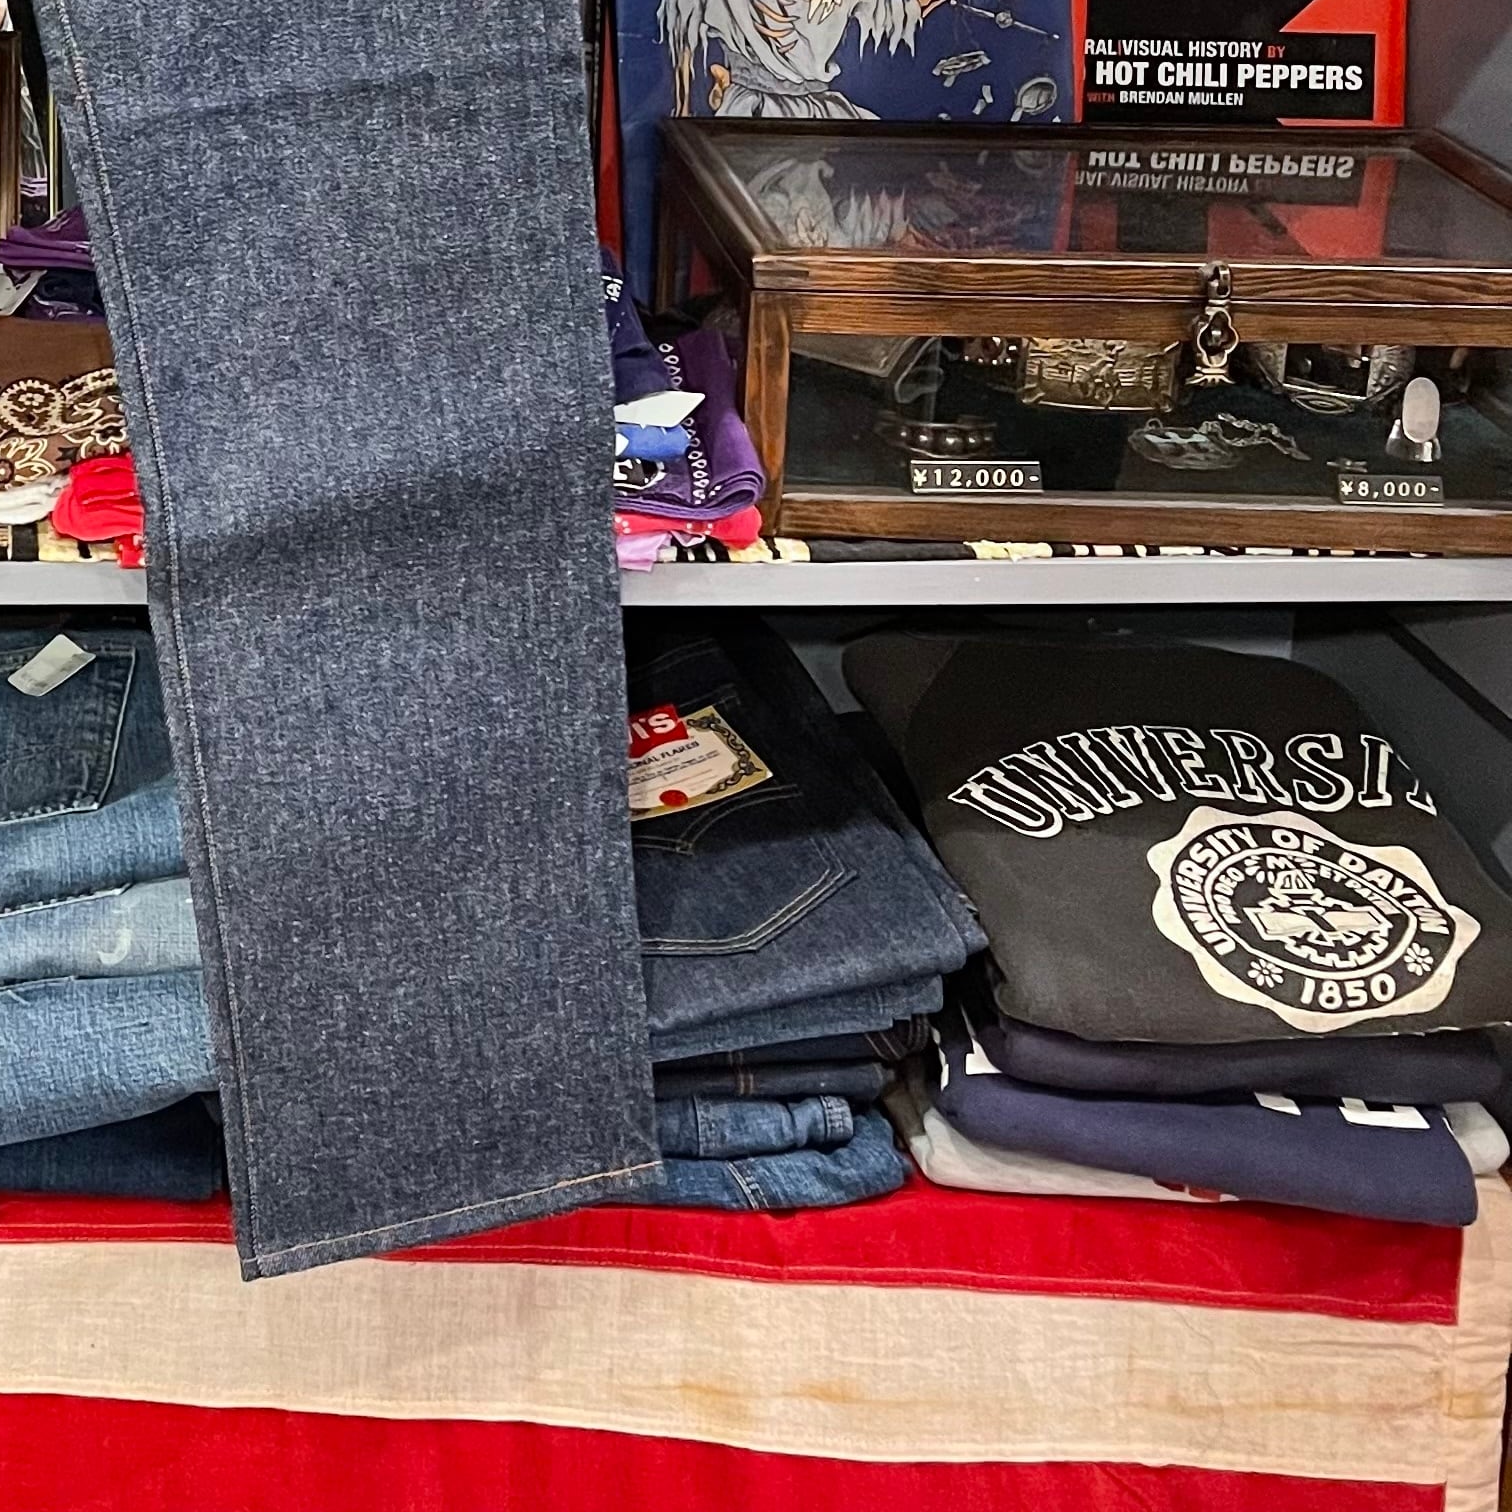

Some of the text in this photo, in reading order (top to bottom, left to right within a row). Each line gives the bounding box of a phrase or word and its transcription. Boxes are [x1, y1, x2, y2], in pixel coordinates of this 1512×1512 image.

[1188, 41, 1262, 58] HISTORY
[1267, 45, 1285, 58] BY
[1095, 61, 1149, 86] HOT
[1157, 62, 1228, 87] CHILI
[1237, 64, 1363, 90] PEPPERS
[1119, 91, 1184, 105] BRENDAN
[1188, 91, 1244, 106] MULLEN
[913, 468, 1040, 488] ¥12,000-
[1340, 480, 1439, 499] ¥8,000-
[1175, 827, 1450, 956] UNIVERSITY OF DAYTON
[1300, 973, 1396, 1010] 1850
